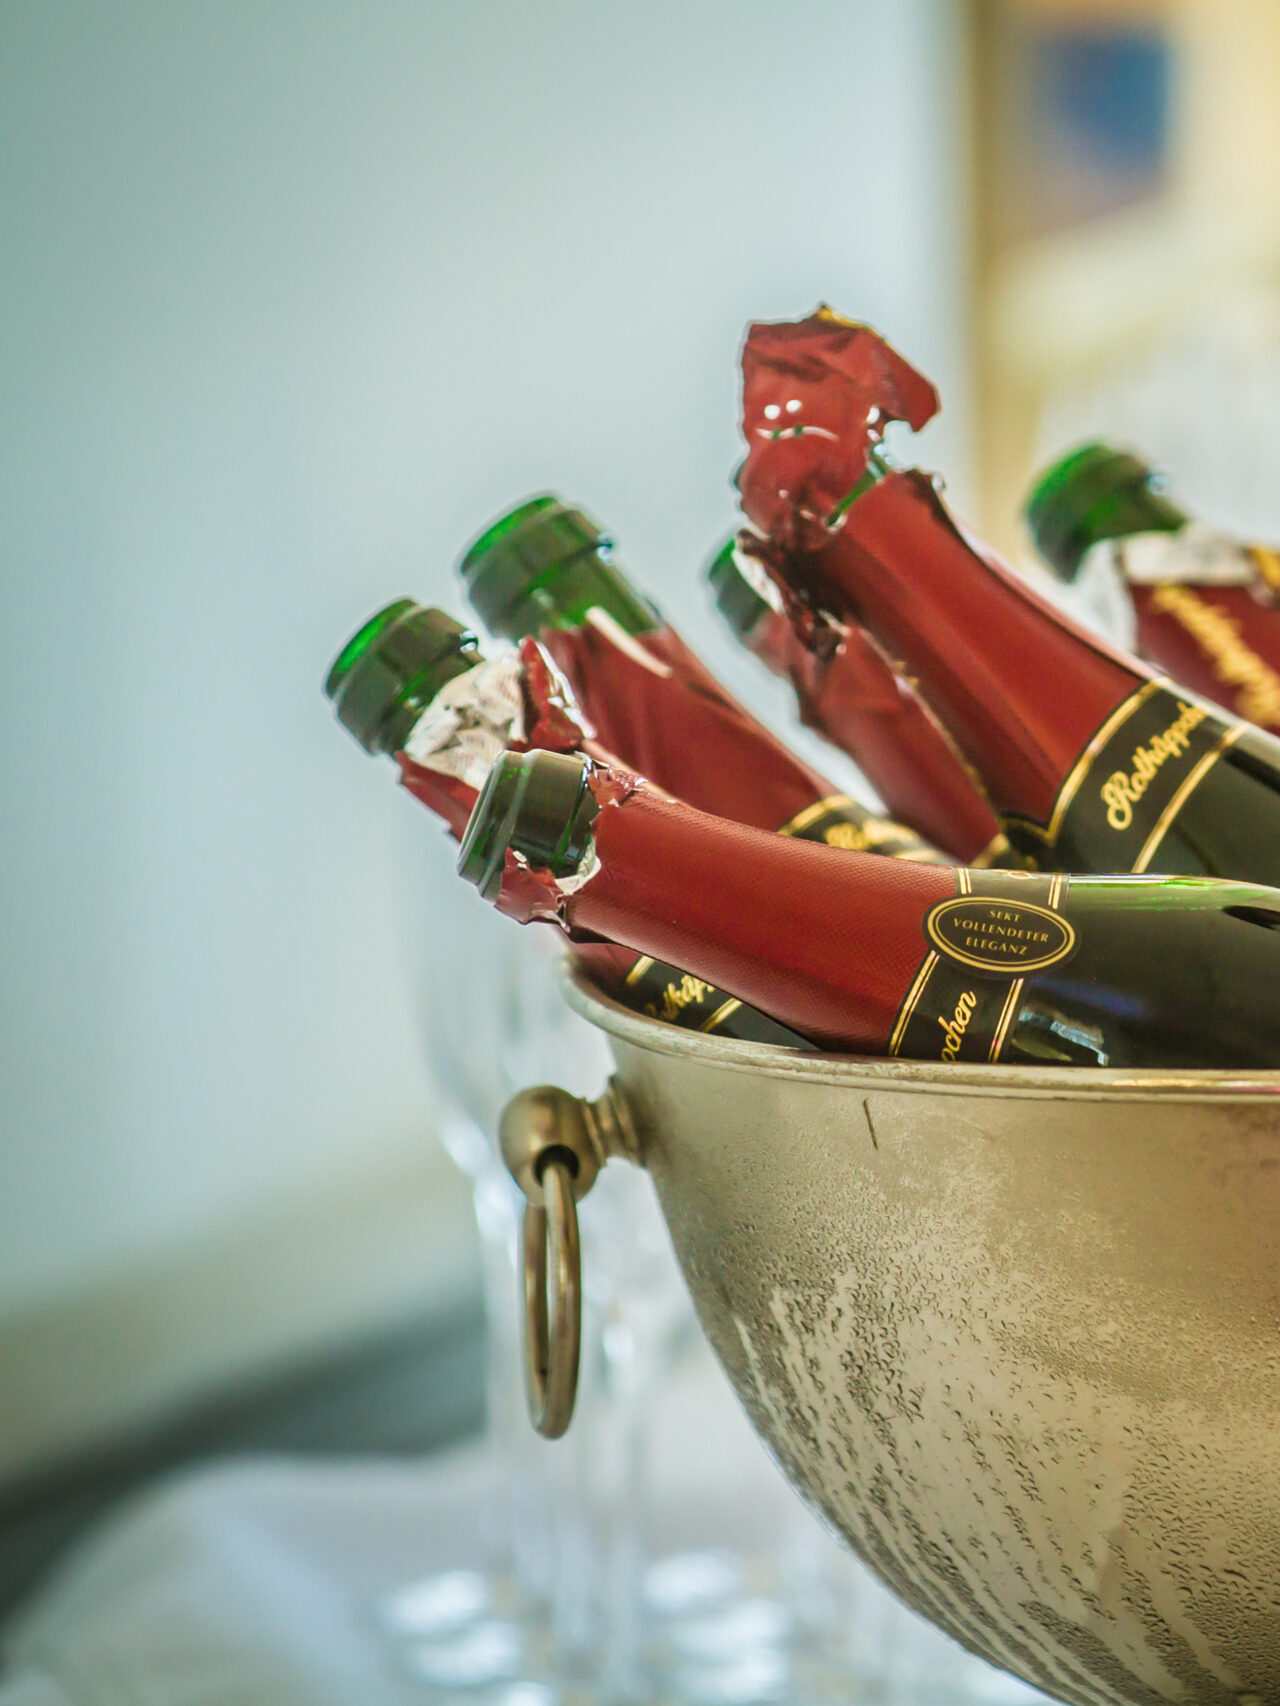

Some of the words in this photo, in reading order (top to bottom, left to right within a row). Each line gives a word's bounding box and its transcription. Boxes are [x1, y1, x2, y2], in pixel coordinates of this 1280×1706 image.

[989, 909, 1021, 923] SEKT
[953, 917, 1049, 943] VOLLENDETER
[965, 936, 1028, 956] ELEGANZ
